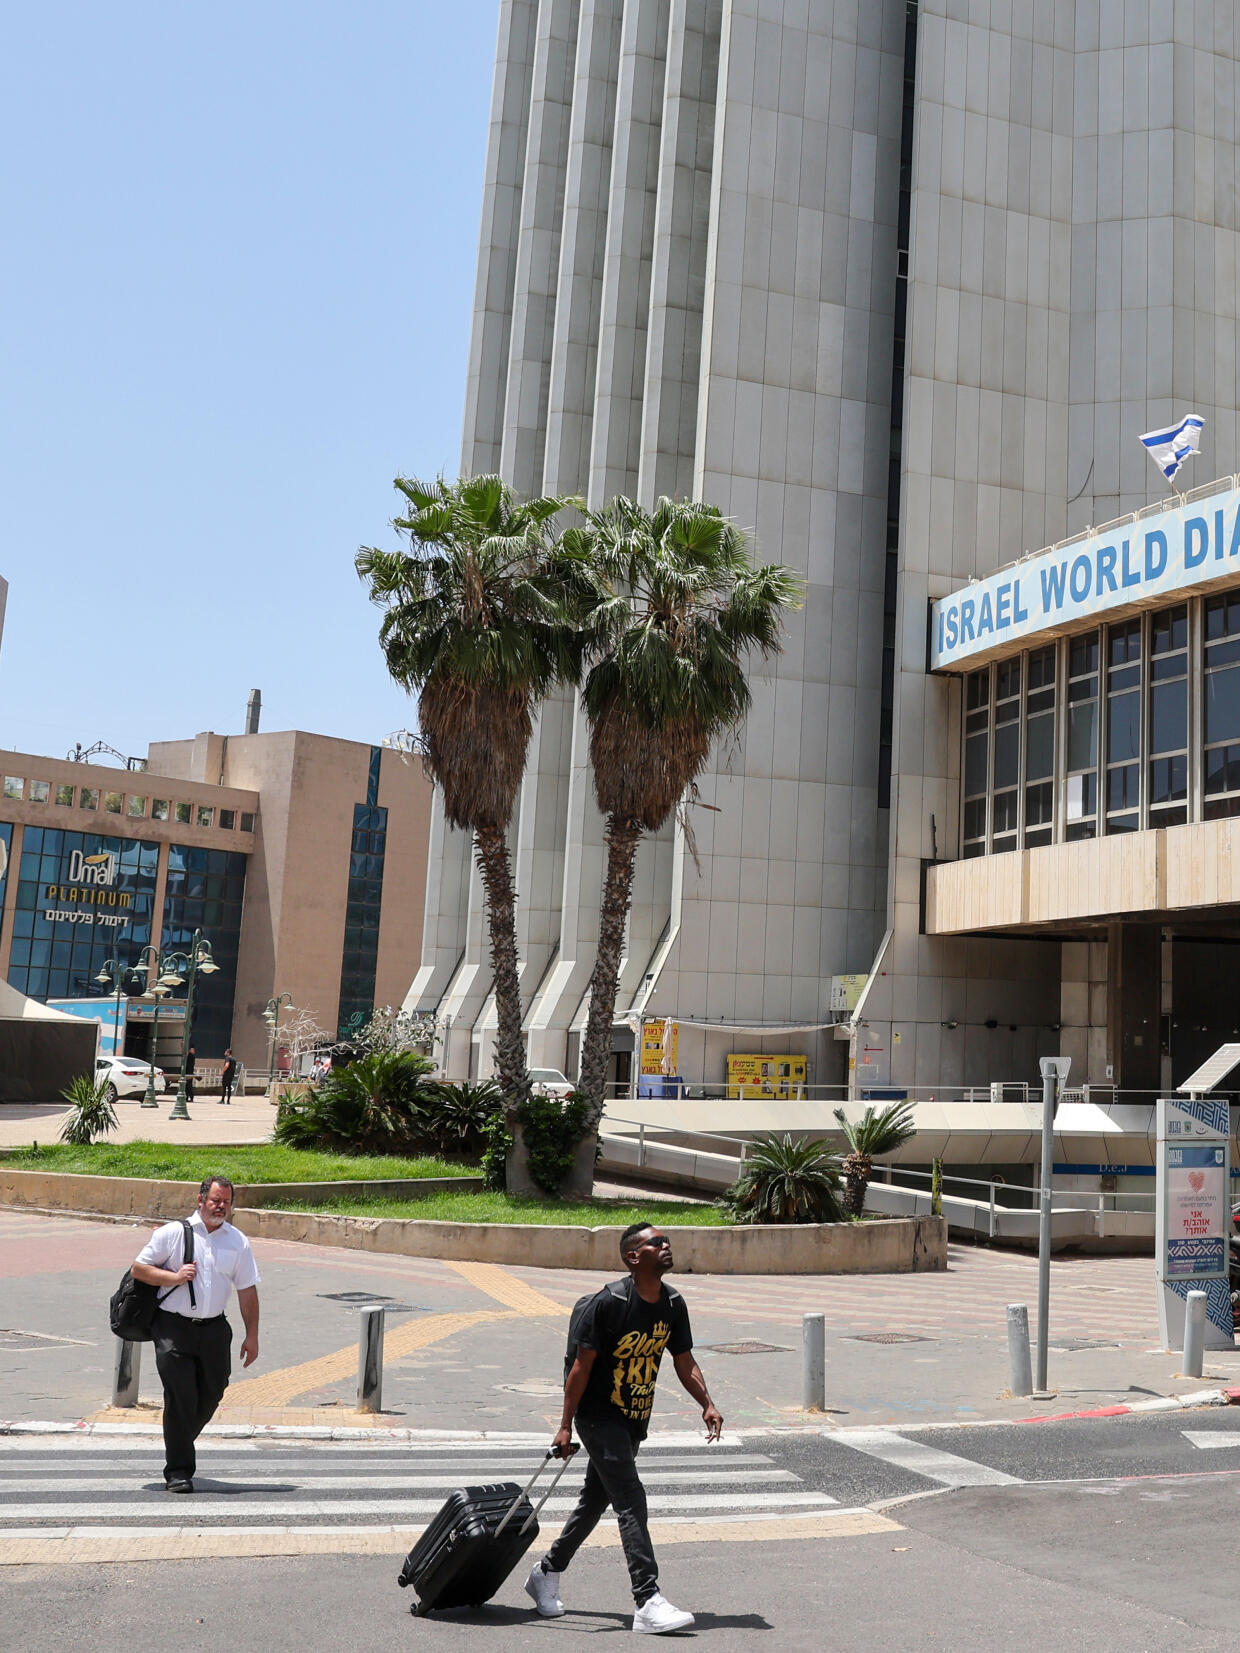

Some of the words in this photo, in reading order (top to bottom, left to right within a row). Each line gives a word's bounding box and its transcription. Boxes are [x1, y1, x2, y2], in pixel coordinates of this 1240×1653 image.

[938, 578, 1028, 654] ISRAEL
[1040, 528, 1168, 614] WORLD
[68, 849, 116, 886] Dmall
[47, 885, 131, 908] PLATINUM
[45, 909, 94, 925] פלטינום
[97, 911, 129, 928] דימול
[1190, 1210, 1202, 1218] אני
[1183, 1219, 1210, 1227] אוהב/ת
